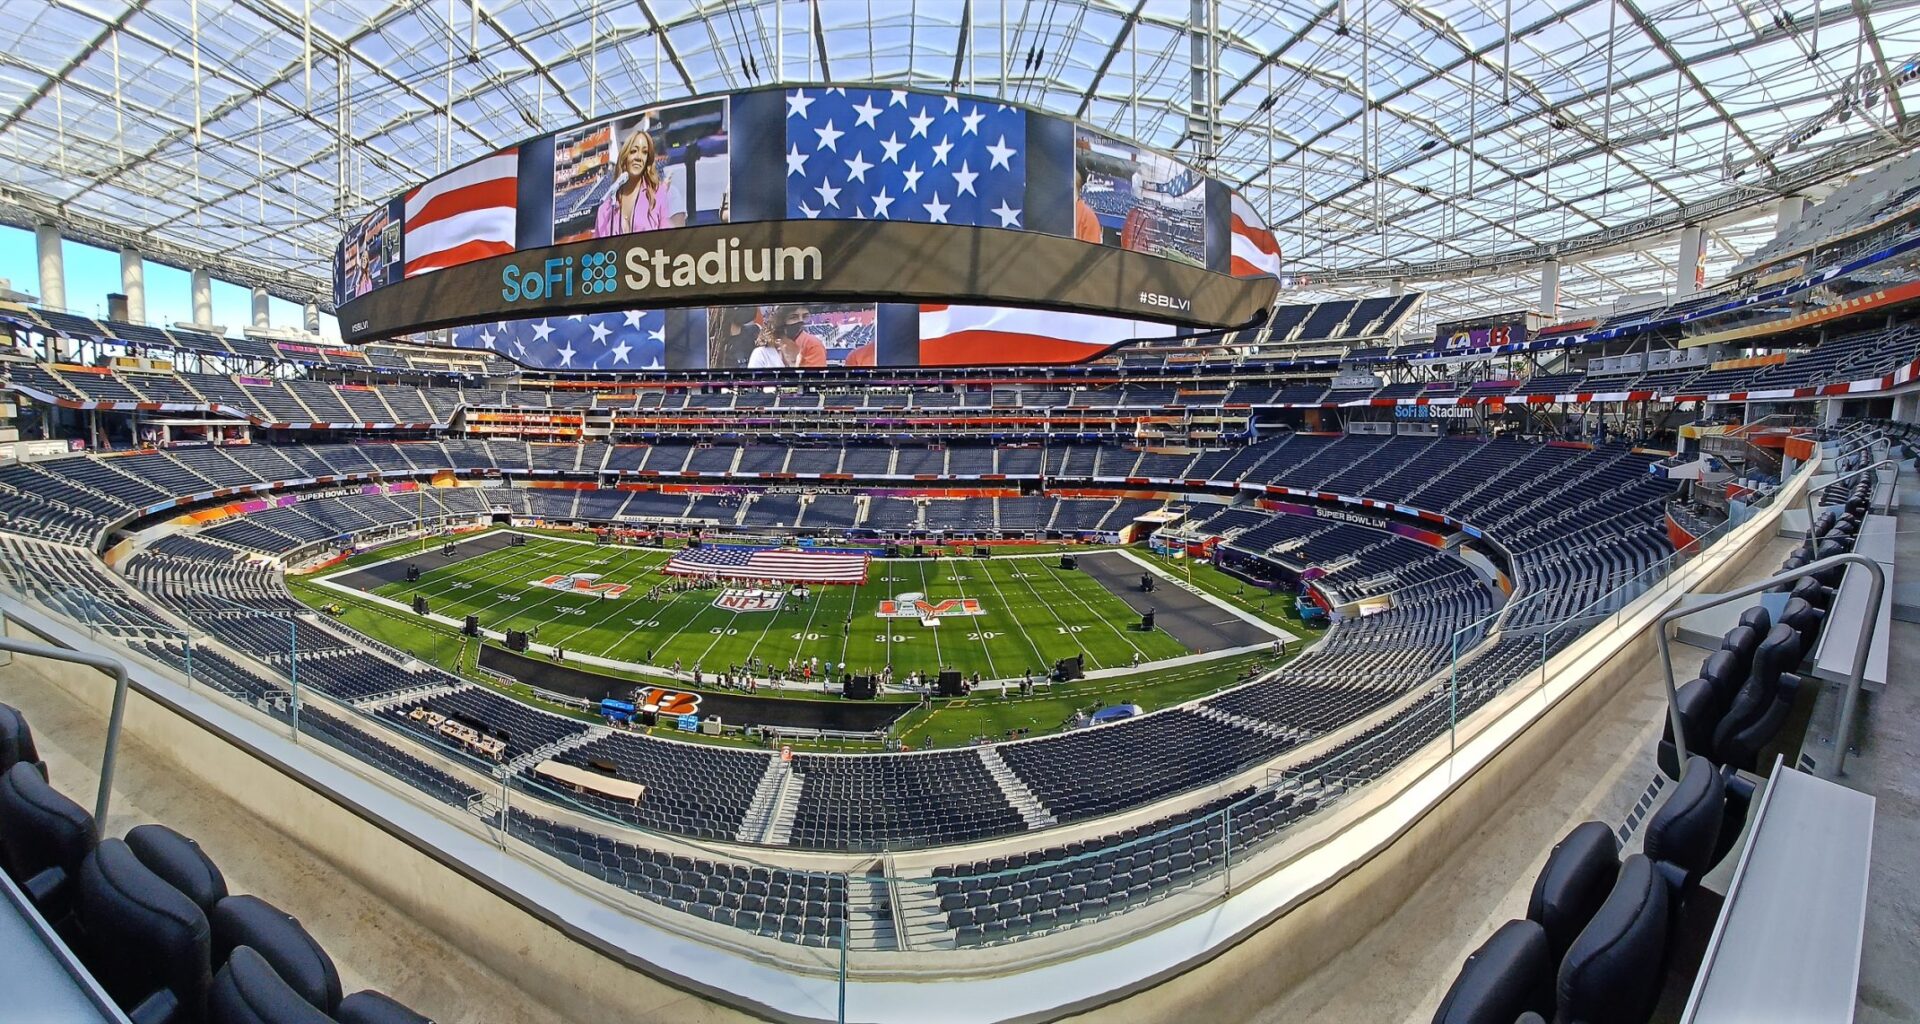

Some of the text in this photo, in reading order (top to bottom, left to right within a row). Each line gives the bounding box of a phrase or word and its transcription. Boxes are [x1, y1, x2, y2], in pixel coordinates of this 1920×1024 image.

[502, 237, 822, 302] SoFi Stadium
[1140, 291, 1190, 311] #SBLVI
[1395, 404, 1473, 418] SoFi Stadium
[296, 493, 324, 502] SUPER
[325, 490, 349, 498] BOWL
[1316, 508, 1386, 529] SUPER BOWL LVI
[721, 596, 771, 609] NFL
[709, 627, 738, 636] 50
[966, 631, 995, 641] 20
[1057, 625, 1082, 635] 10
[791, 632, 819, 641] 40
[875, 634, 906, 643] 30
